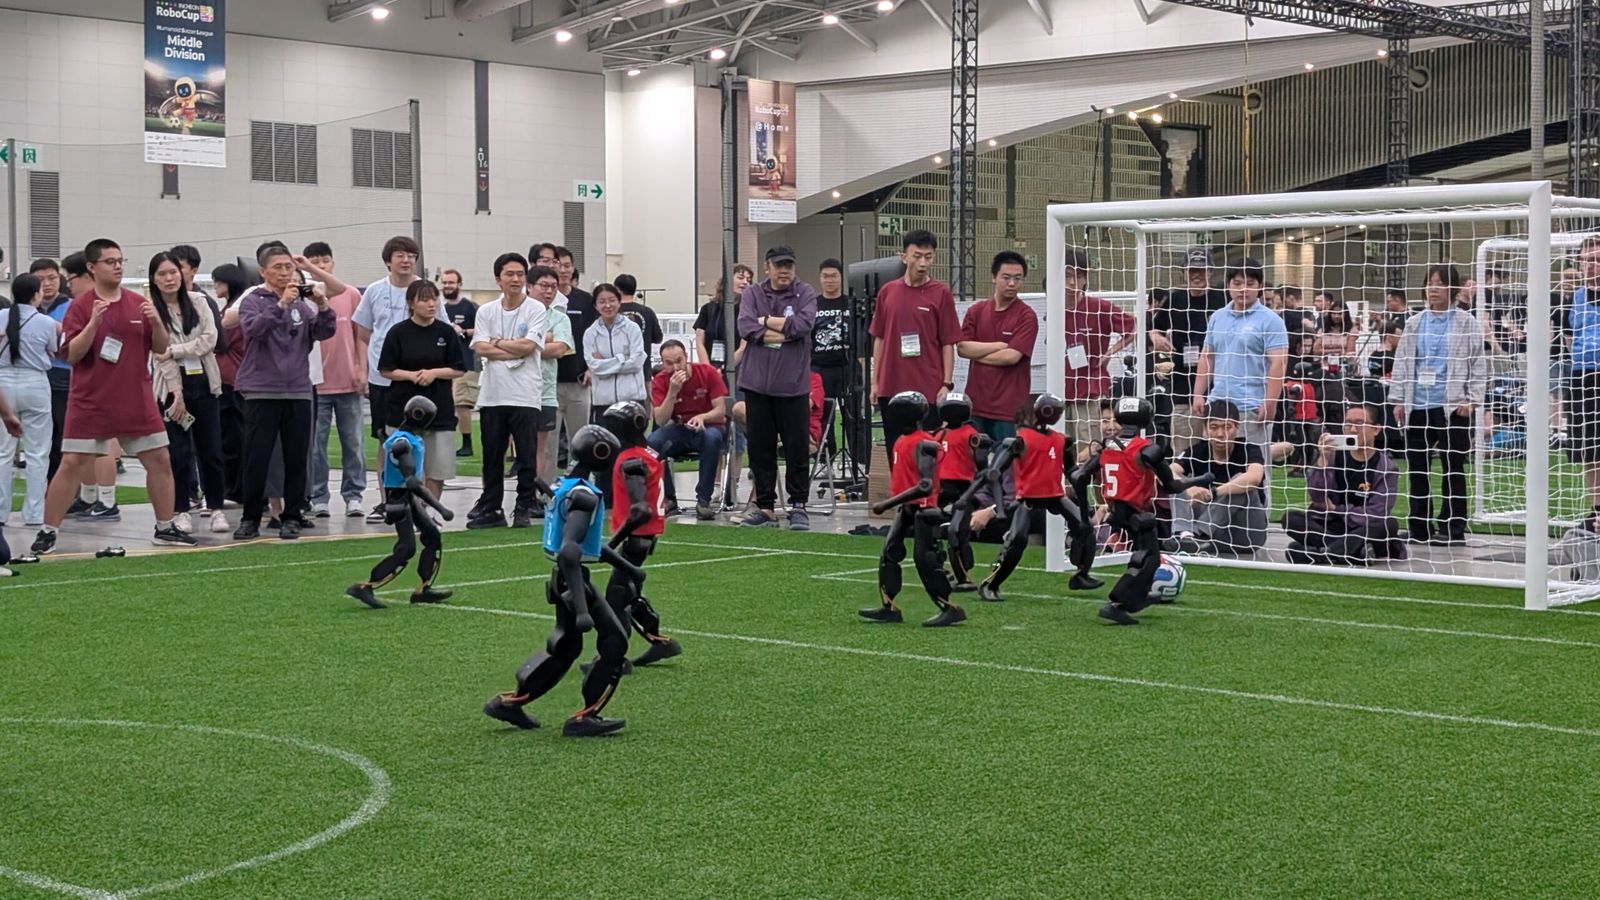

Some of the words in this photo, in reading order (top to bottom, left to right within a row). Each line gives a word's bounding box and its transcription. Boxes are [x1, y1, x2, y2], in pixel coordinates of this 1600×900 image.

[156, 6, 199, 22] RoboCup
[167, 34, 203, 48] Middle
[164, 47, 205, 61] Division
[1048, 446, 1056, 459] 4
[1104, 463, 1120, 497] 5
